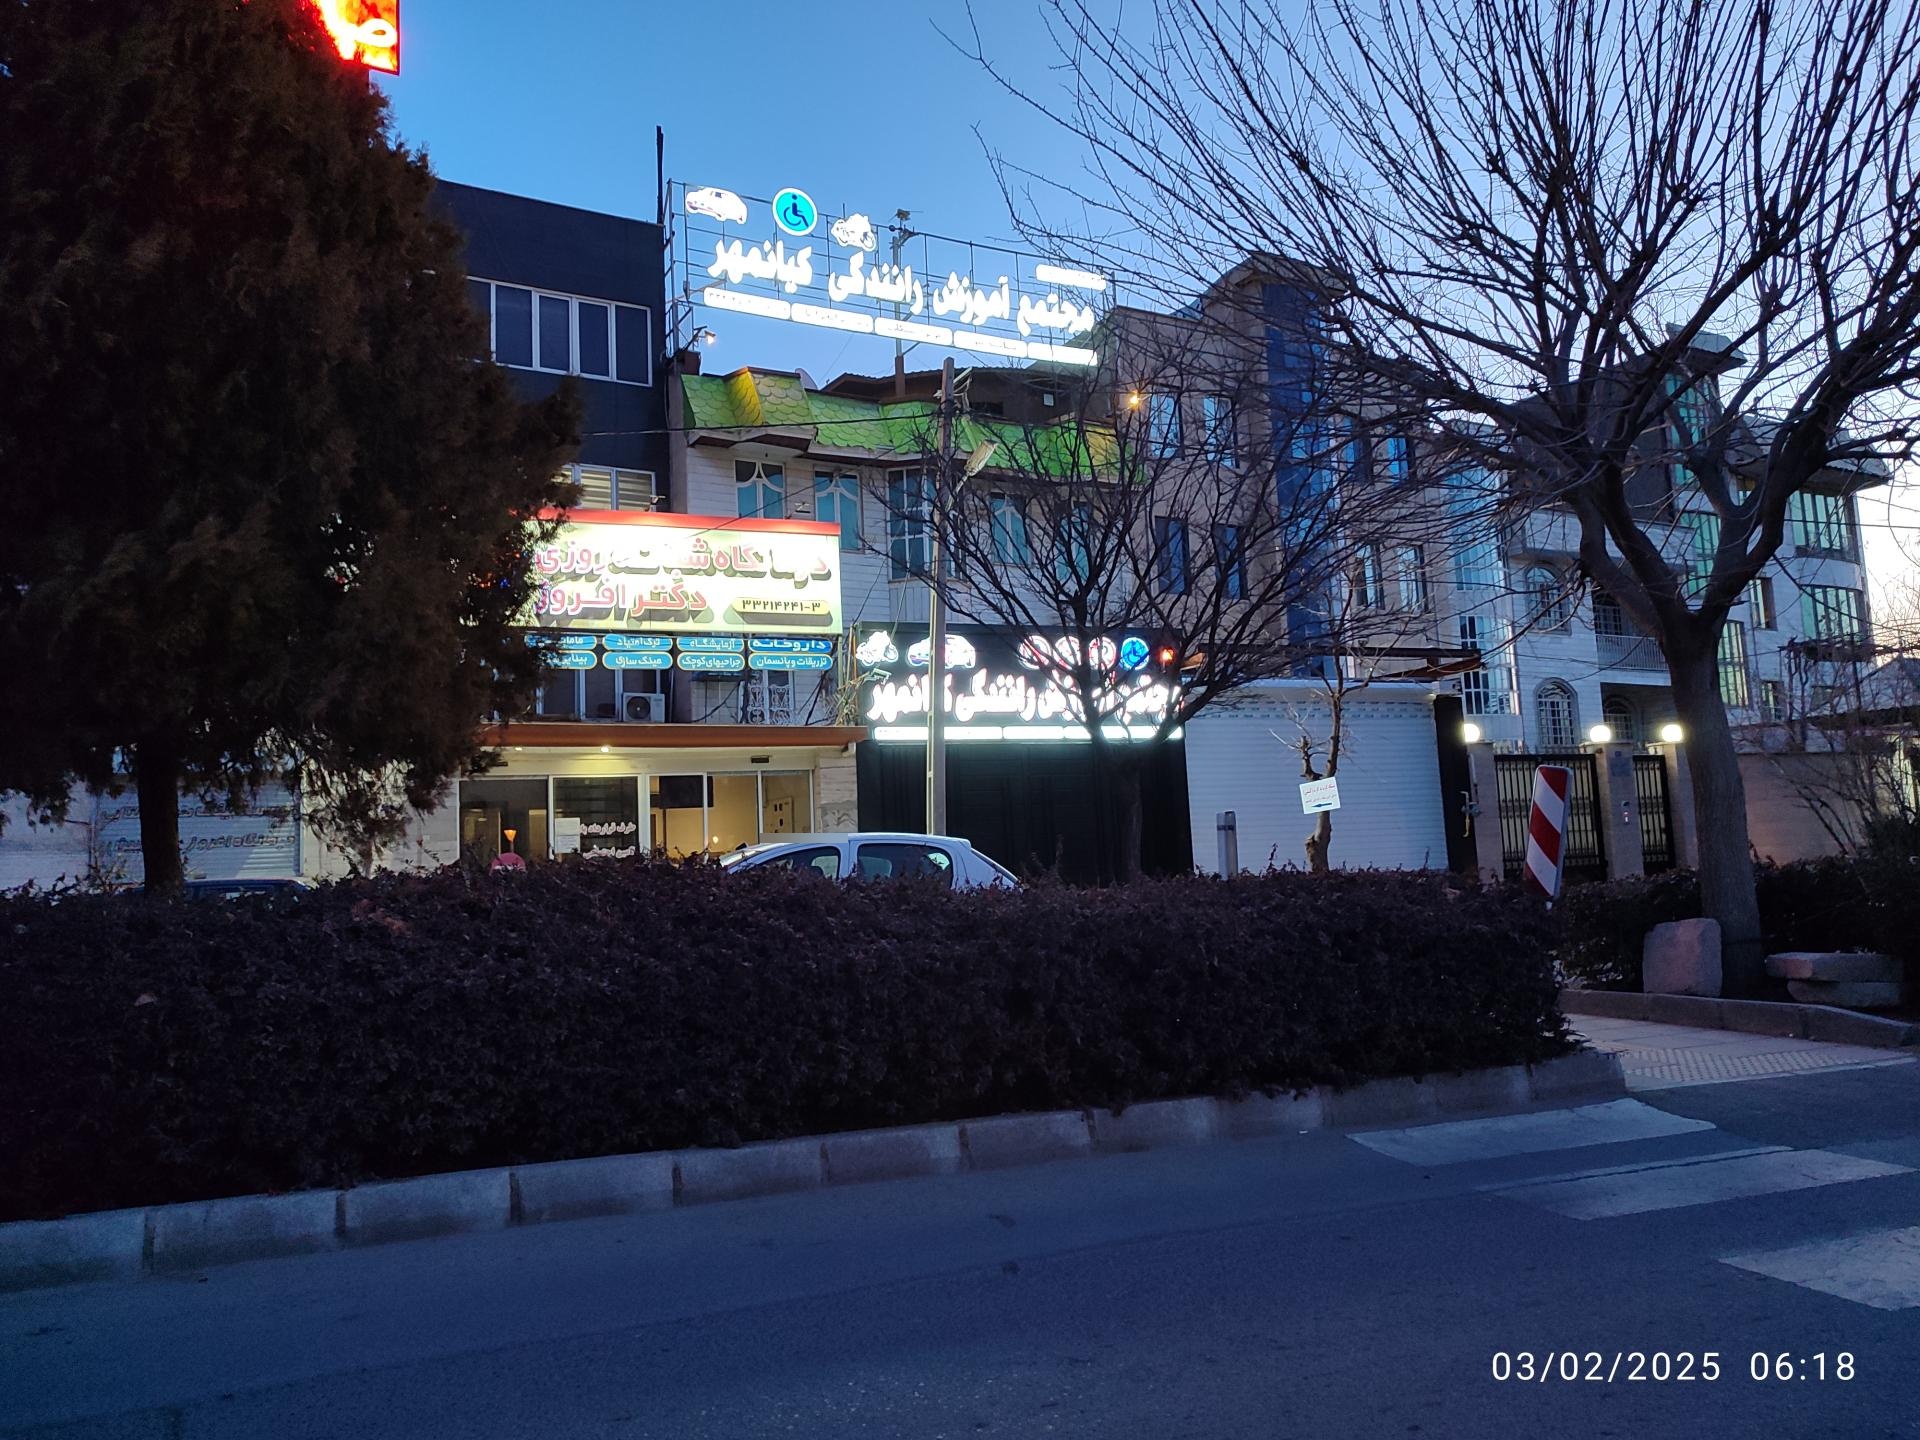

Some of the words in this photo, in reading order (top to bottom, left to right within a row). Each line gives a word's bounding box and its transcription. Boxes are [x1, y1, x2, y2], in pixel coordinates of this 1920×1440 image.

[828, 251, 923, 315] رانندگی
[631, 582, 707, 617] دکتر
[689, 639, 736, 650] آزمایشگاه
[752, 639, 827, 651] داروخانه
[615, 656, 640, 668] سازی
[641, 656, 663, 666] عینک
[681, 656, 706, 669] کوچک
[756, 656, 790, 668] پانسمان
[798, 656, 828, 668] تزریقات
[866, 673, 953, 723] کانمهر
